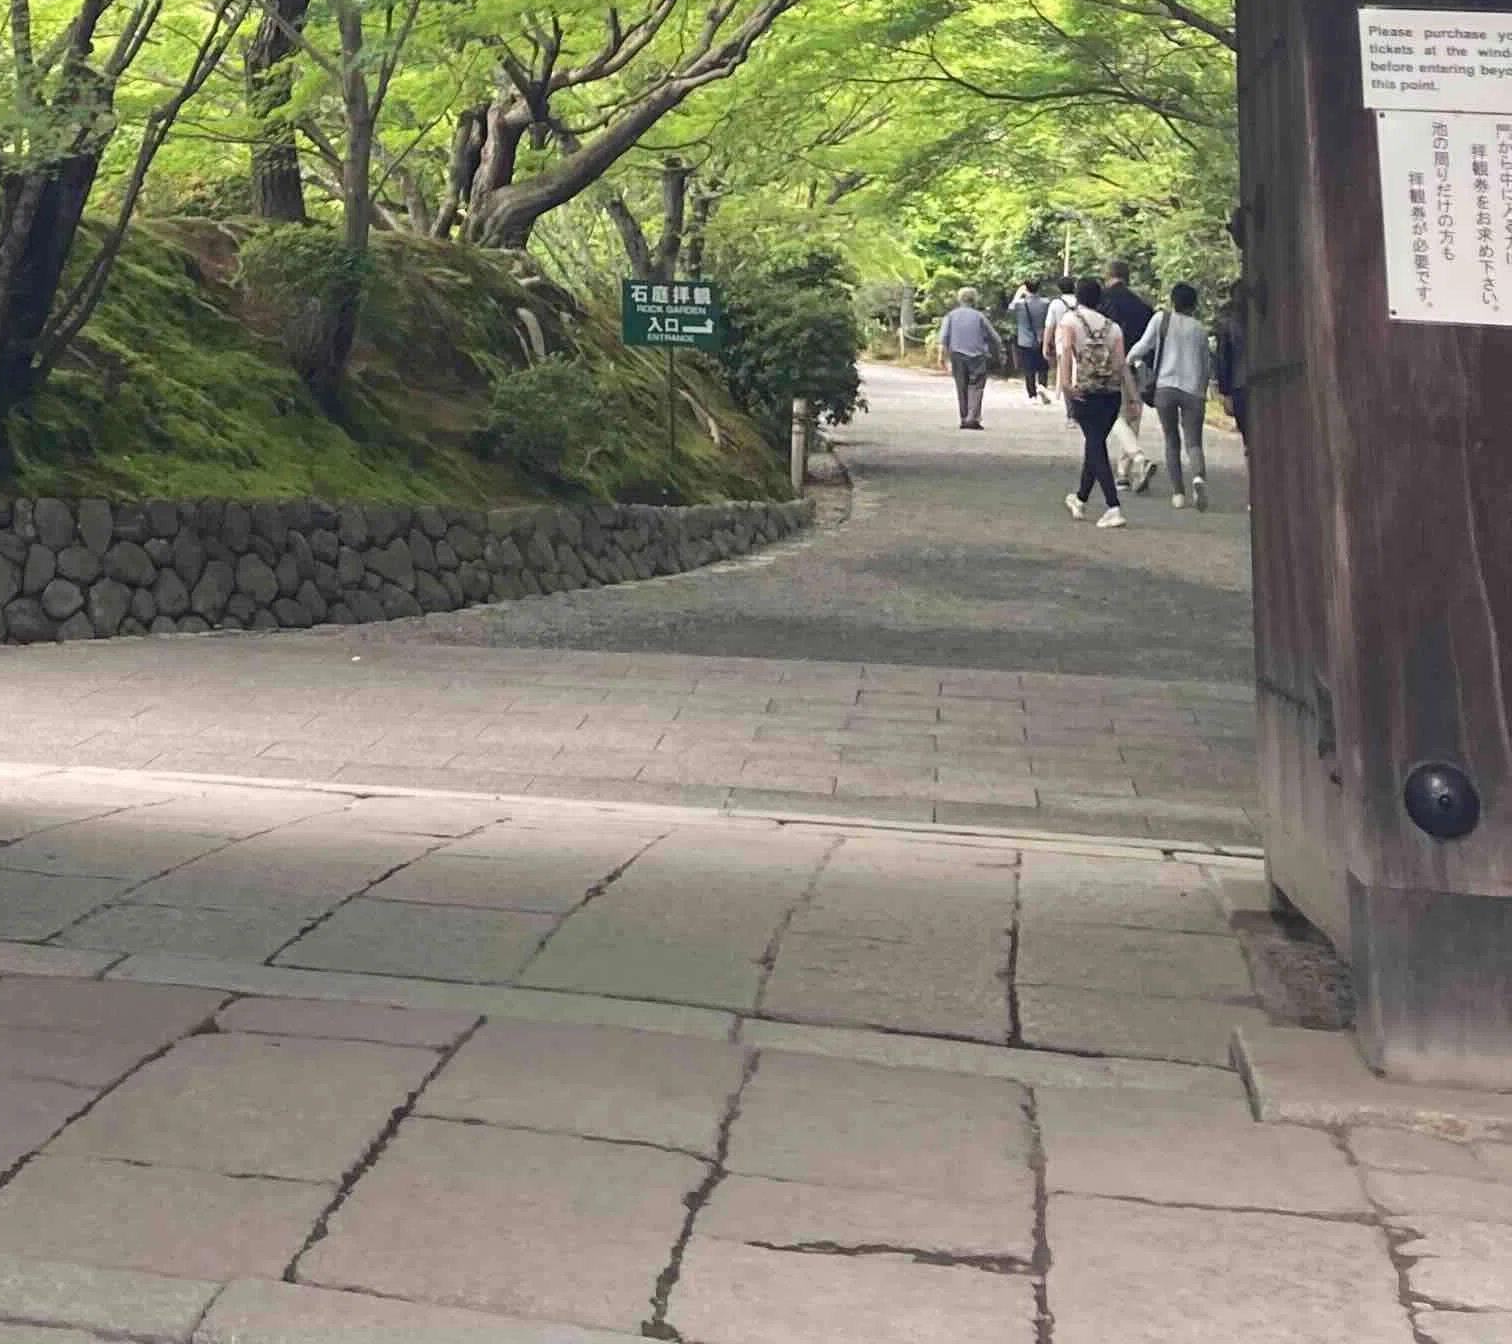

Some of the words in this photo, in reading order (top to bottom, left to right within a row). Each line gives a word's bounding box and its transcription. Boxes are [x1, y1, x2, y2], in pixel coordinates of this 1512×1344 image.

[1368, 26, 1413, 38] Please
[1424, 29, 1487, 41] purchase
[1369, 43, 1414, 55] tickets
[1424, 45, 1436, 56] at
[1447, 46, 1468, 57] the
[1370, 60, 1414, 72] before
[1419, 64, 1475, 78] entering
[1371, 79, 1396, 90] this
[630, 285, 711, 305] 石庭拝観
[636, 304, 664, 313] ROCK
[666, 305, 706, 315] GARDEN
[648, 317, 679, 332] 入口
[648, 332, 694, 343] ENTRANCE
